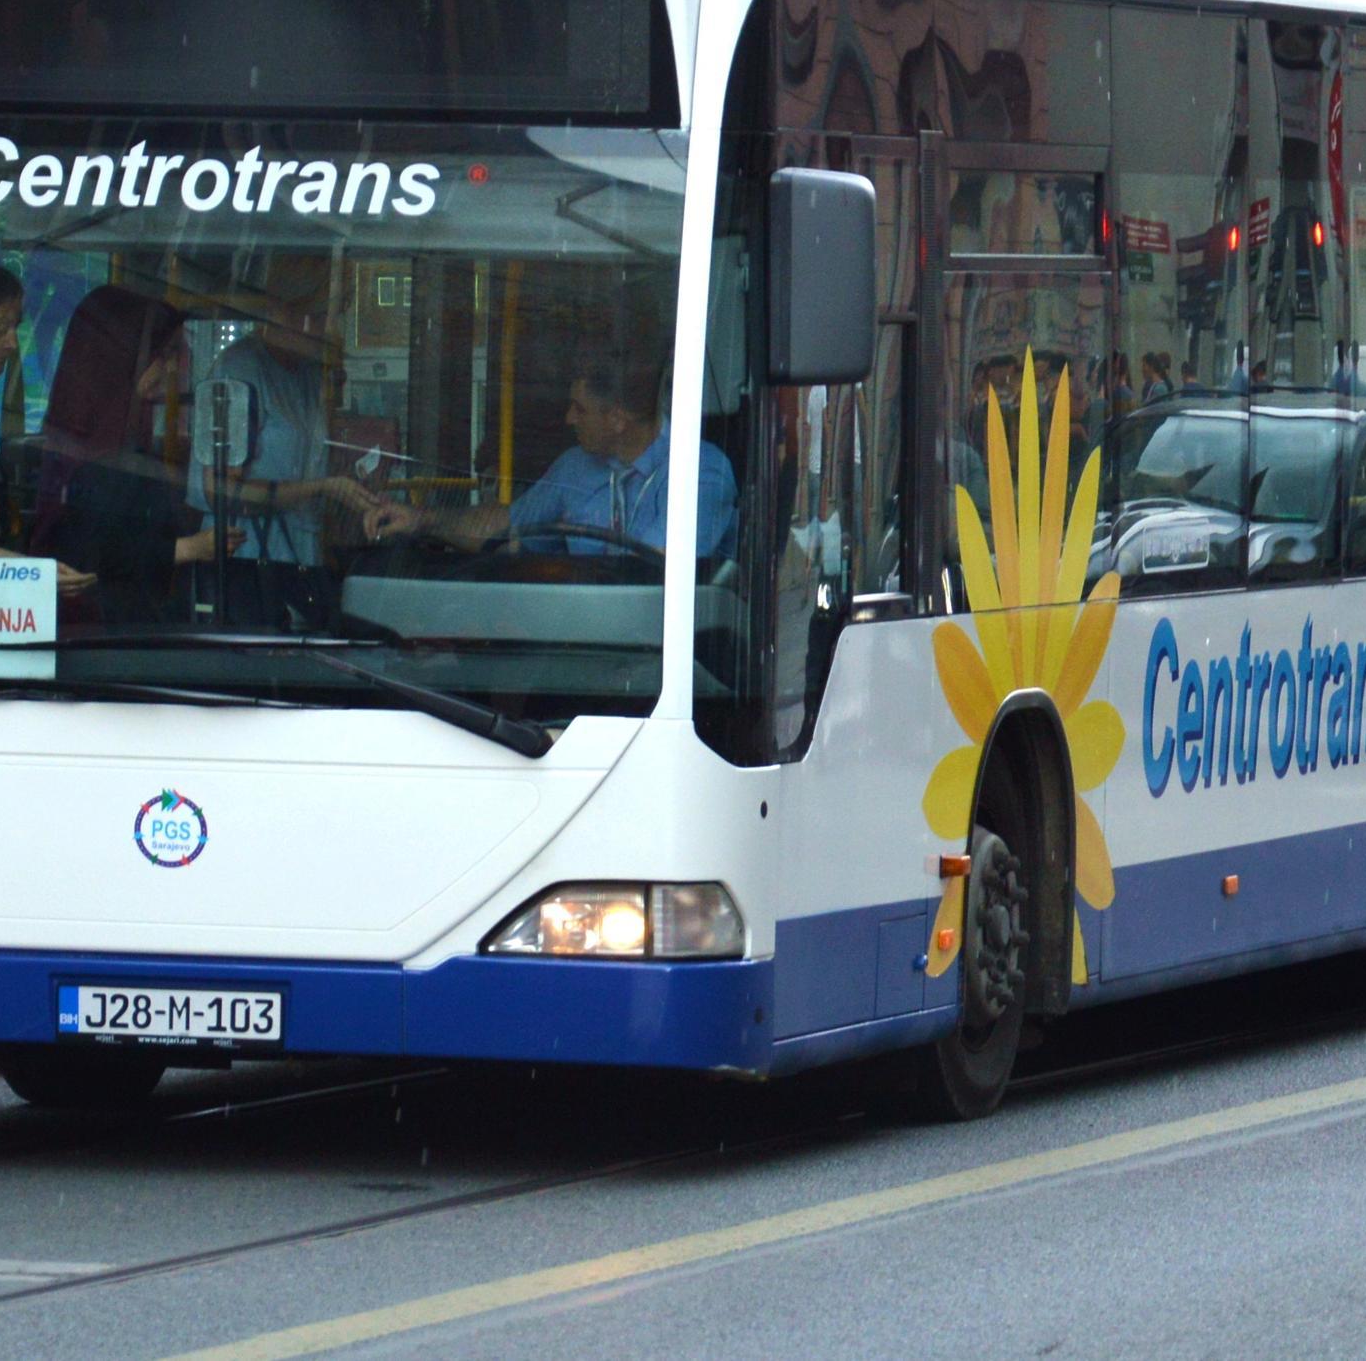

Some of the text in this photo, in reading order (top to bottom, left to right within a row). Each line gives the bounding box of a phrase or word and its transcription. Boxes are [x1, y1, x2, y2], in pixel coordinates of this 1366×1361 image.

[152, 819, 191, 841] PGS
[152, 841, 191, 851] Sarajevo
[59, 993, 274, 1034] BIH J28-M-103
